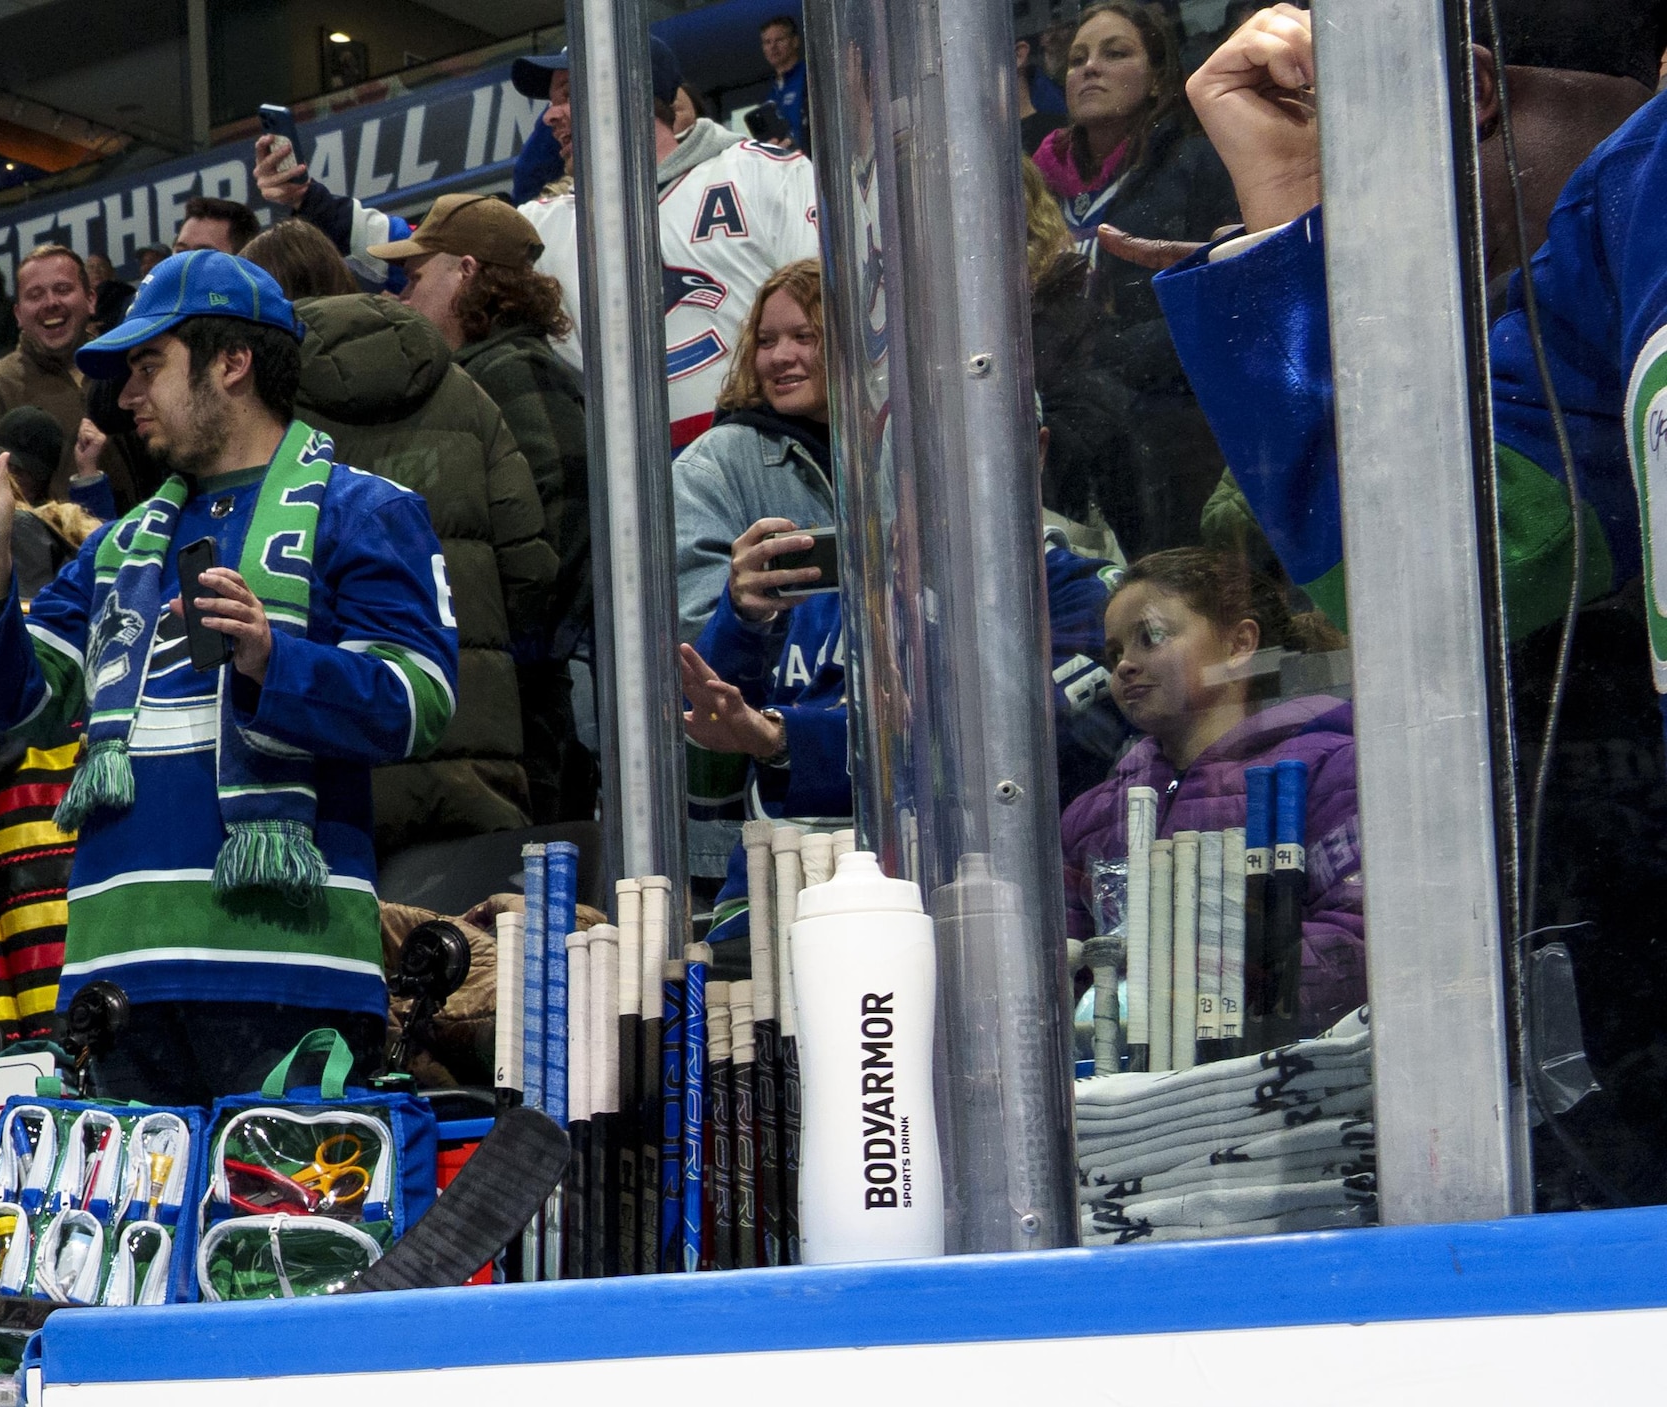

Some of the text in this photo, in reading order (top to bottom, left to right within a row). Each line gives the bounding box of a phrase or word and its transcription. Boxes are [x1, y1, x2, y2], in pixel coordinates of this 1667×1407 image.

[308, 104, 444, 200] ALL
[690, 180, 750, 244] A
[860, 991, 899, 1210] BODYARMOR
[900, 1115, 913, 1209] SPORTS DRINK
